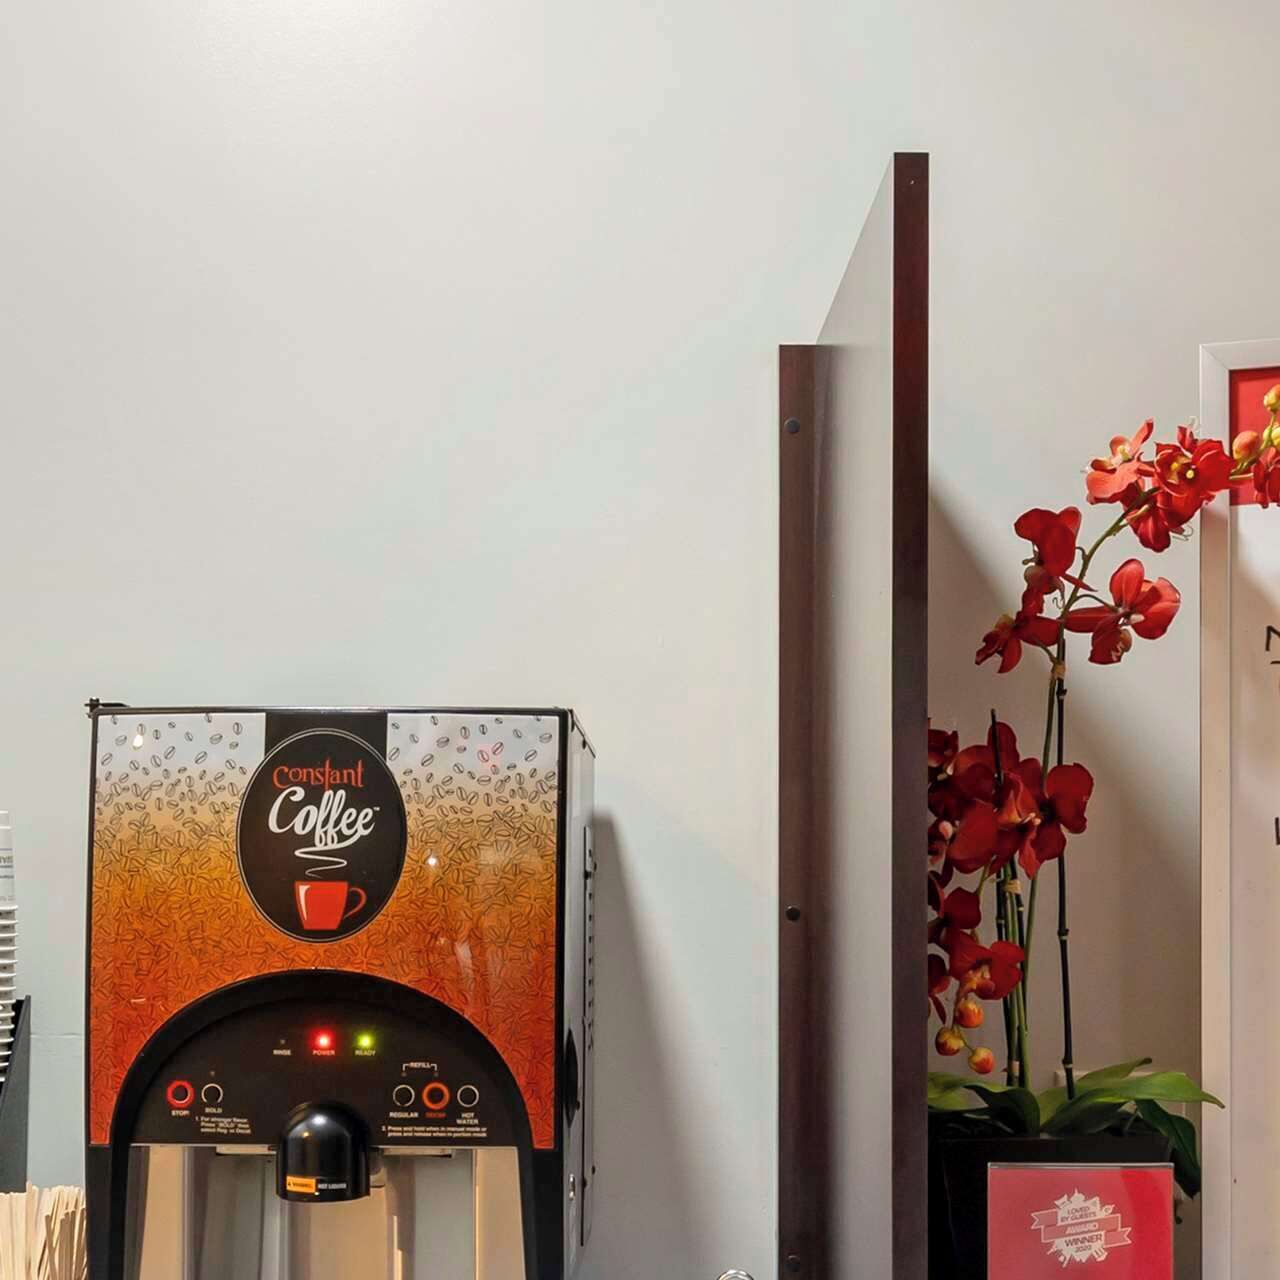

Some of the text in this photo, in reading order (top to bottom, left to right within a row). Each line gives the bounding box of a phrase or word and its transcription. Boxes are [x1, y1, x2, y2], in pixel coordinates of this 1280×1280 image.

[268, 786, 376, 849] Coffee
[1067, 1206, 1090, 1215] LOVED
[1070, 1212, 1097, 1221] GUESTS
[1064, 1233, 1103, 1247] WINNER
